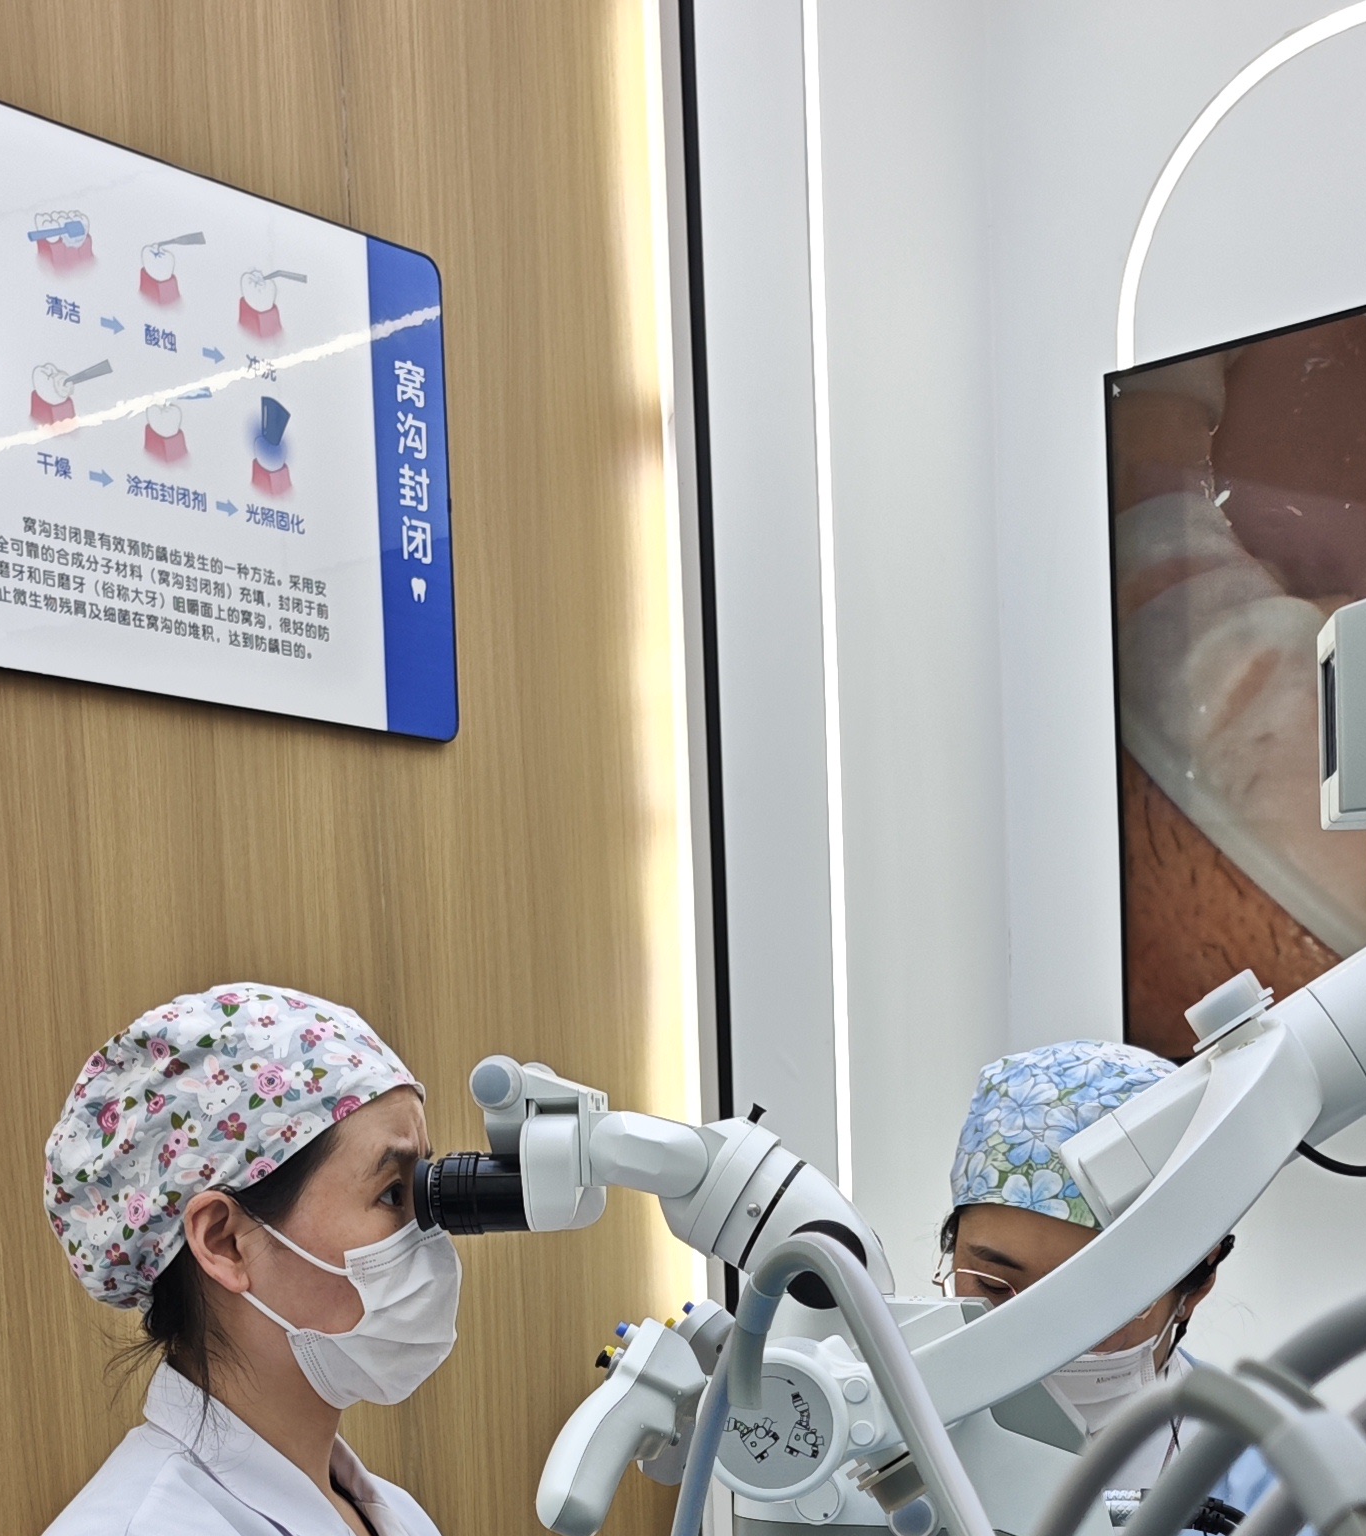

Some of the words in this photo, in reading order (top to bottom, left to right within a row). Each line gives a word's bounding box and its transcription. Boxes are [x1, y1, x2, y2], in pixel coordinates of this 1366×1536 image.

[45, 293, 81, 325] 清洁
[144, 323, 178, 354] 酸蚀
[36, 451, 73, 480] 干燥
[393, 359, 433, 565] 窝沟封闭
[126, 473, 208, 513] 涂布封闭剂
[246, 502, 306, 535] 光照固化
